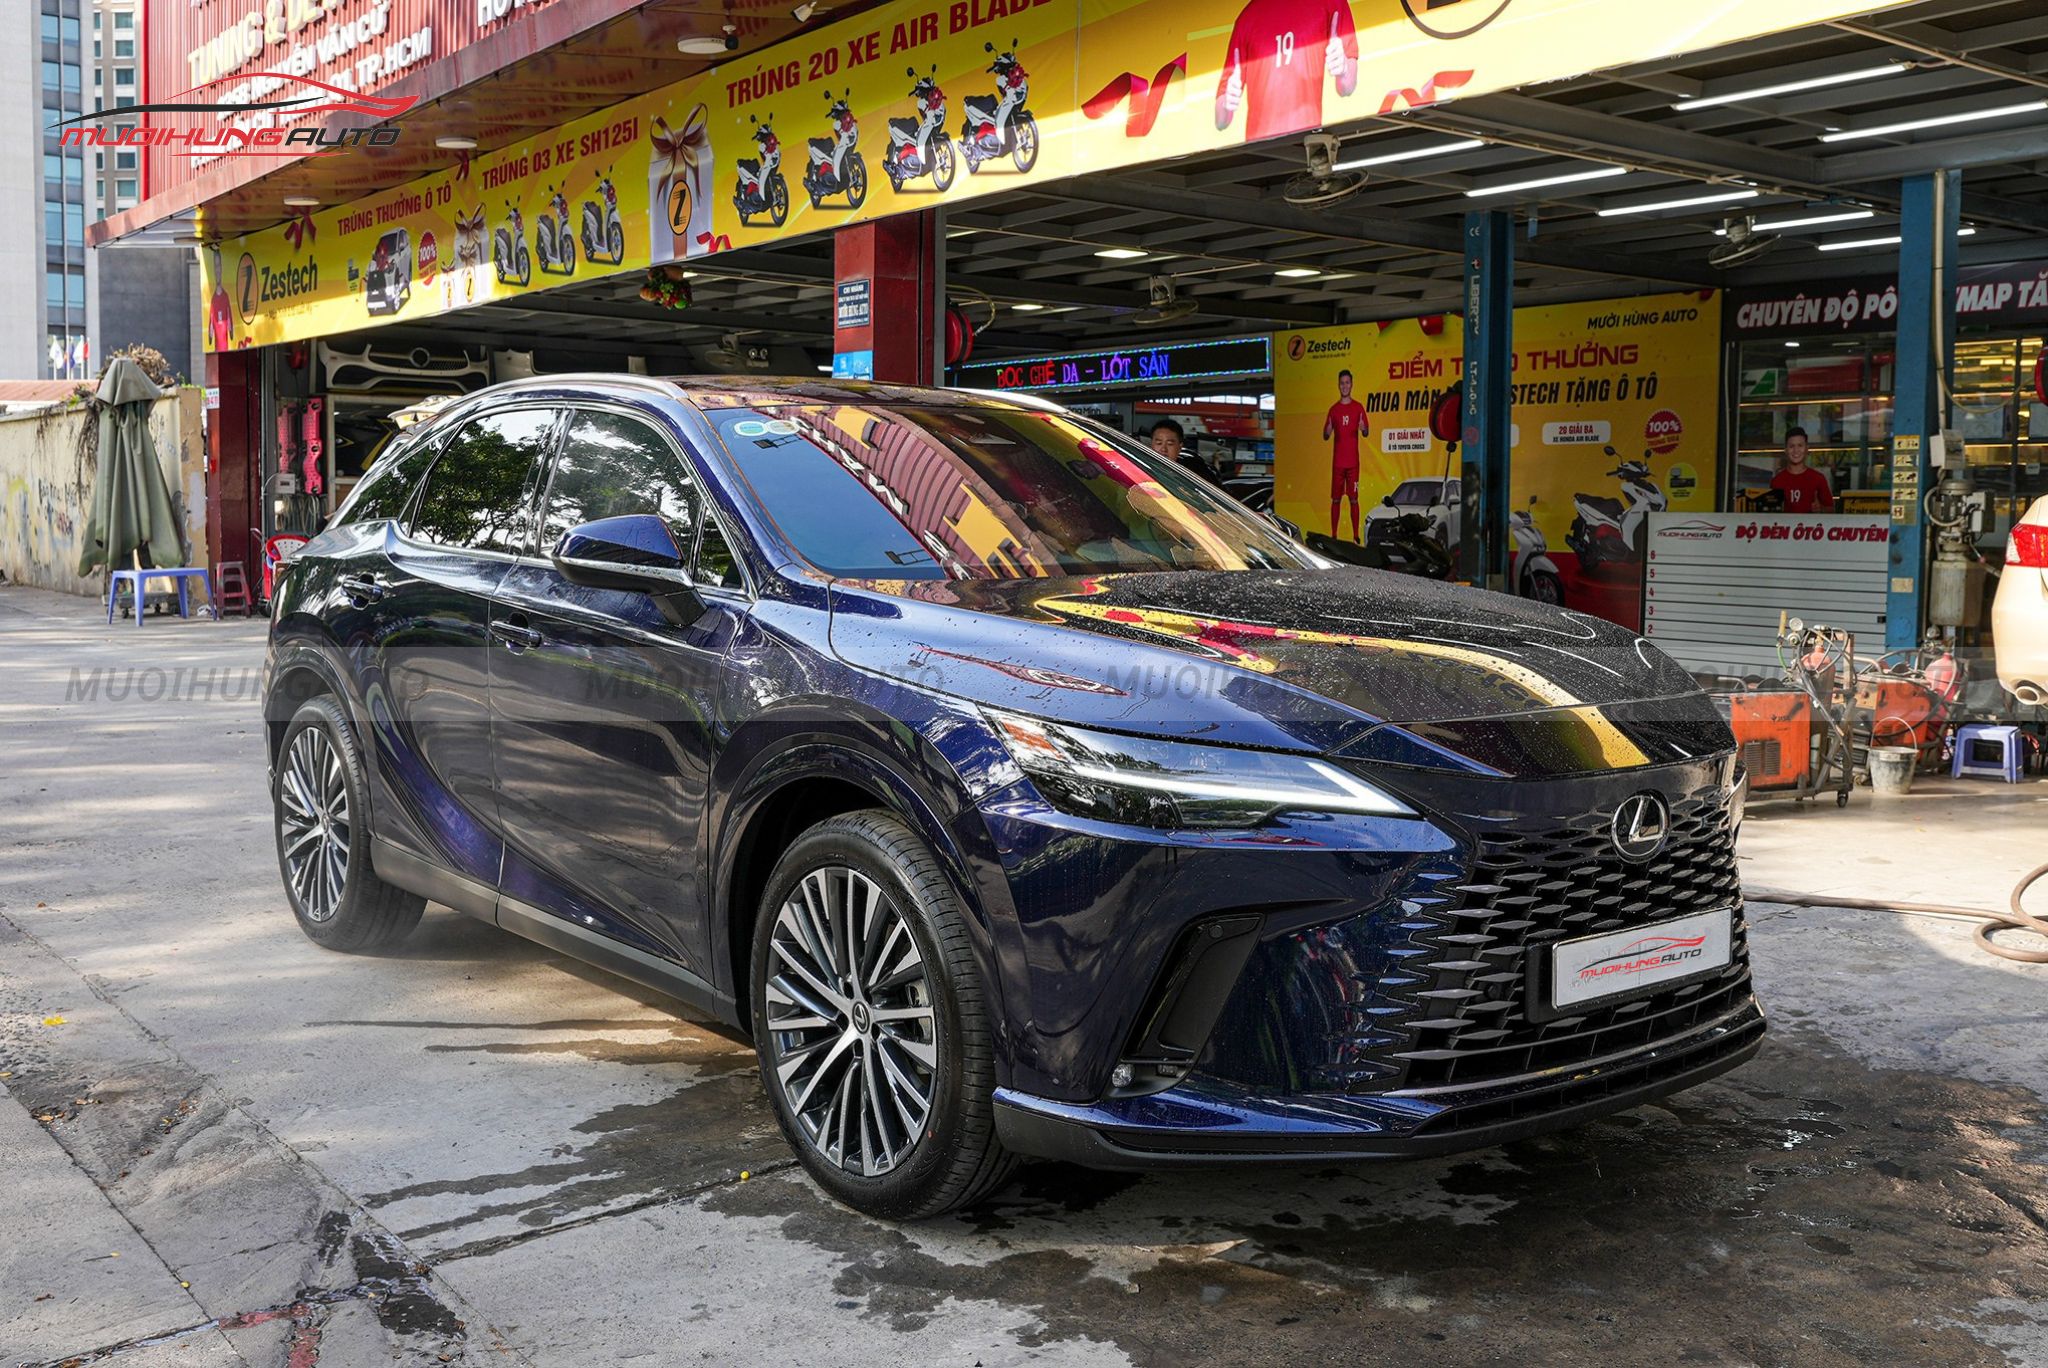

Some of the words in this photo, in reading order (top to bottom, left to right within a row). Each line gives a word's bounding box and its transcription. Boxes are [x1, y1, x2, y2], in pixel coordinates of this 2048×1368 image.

[356, 26, 431, 86] TP.HCM
[726, 64, 801, 108] TRÚNG
[808, 47, 838, 81] 20
[847, 31, 881, 69] XE
[890, 12, 939, 54] AIR
[949, 0, 1053, 35] BLA
[1275, 31, 1295, 67] 19
[482, 155, 528, 190] TRÚNG
[533, 153, 550, 173] 03
[556, 140, 575, 166] XE
[580, 117, 639, 157] SH125I
[338, 211, 373, 236] TRÚNG
[376, 192, 422, 223] THƯỞNG
[425, 190, 432, 210] Ô
[436, 183, 451, 206] TÔ
[420, 244, 436, 261] 100%
[261, 254, 318, 302] Zestech
[1587, 312, 1619, 330] MƯỜI
[1622, 310, 1659, 325] HÙNG
[1661, 308, 1698, 324] AUTO
[1737, 293, 1822, 328] CHUYÊN
[1824, 289, 1860, 329] ĐỘ
[1862, 285, 1898, 320] PÔ
[1956, 282, 2014, 313] MAP
[1307, 337, 1351, 353] Zestech
[1527, 341, 1639, 371] THƯỞNG
[1062, 362, 1079, 383] DA
[1101, 353, 1131, 380] LÓT
[1139, 350, 1169, 377] SÀN
[1388, 350, 1442, 380] ĐIỂM
[1366, 391, 1400, 413] MUA
[1510, 381, 1560, 405] STECH
[1566, 376, 1611, 408] TẶNG
[1616, 373, 1629, 401] Ô
[1636, 371, 1658, 400] TÔ
[1649, 420, 1680, 433] 100%
[1790, 489, 1800, 503] 19
[1735, 521, 1758, 543] ĐỘ
[1760, 522, 1790, 540] ĐÈN
[1793, 523, 1825, 541] ÔTÔ
[1827, 524, 1889, 542] CHUYÊN
